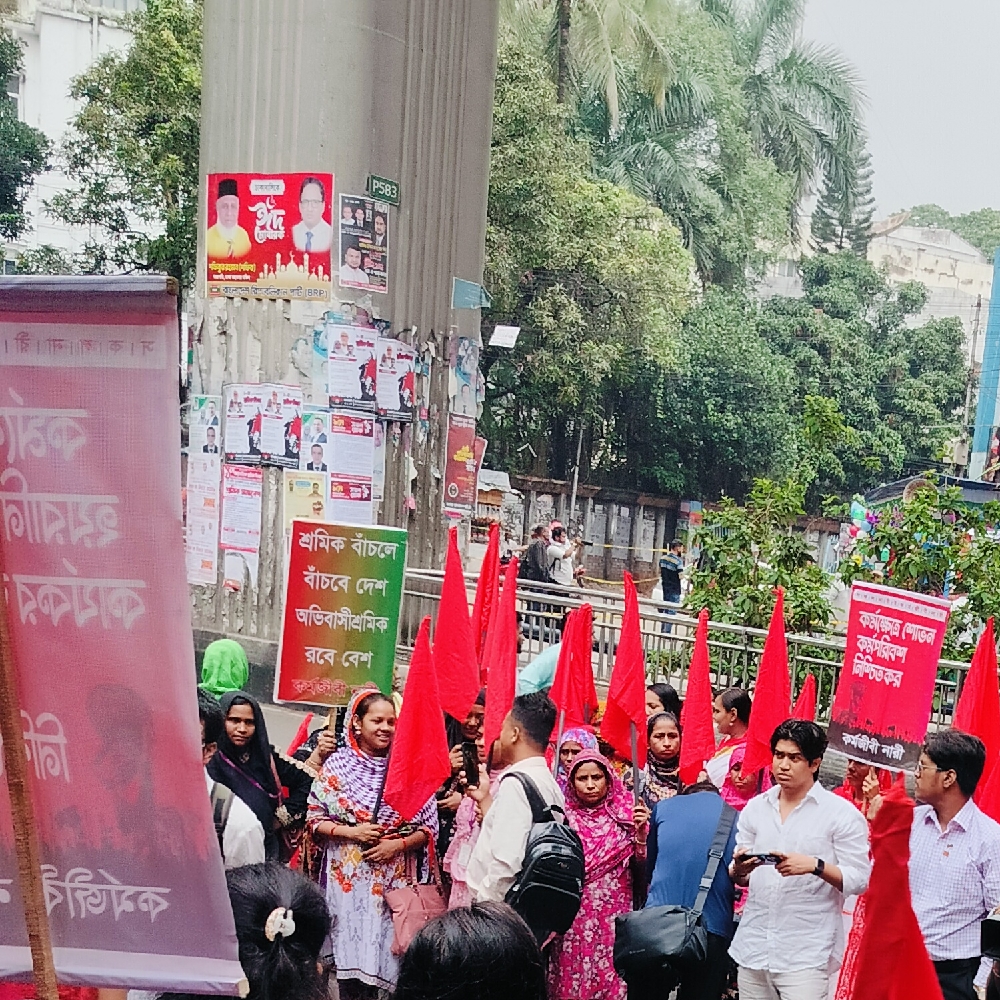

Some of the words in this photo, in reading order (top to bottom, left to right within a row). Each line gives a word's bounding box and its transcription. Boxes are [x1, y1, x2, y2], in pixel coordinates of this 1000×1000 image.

[372, 177, 397, 197] P583
[299, 528, 347, 554] শ্রমিক
[351, 533, 399, 560] বাঁচলে
[303, 565, 351, 593] বাঁচবে
[356, 578, 389, 597] দেশ
[305, 646, 337, 667] রবে
[342, 650, 374, 669] বেশ
[842, 732, 880, 755] কর্মজীবী
[881, 743, 905, 760] নারী
